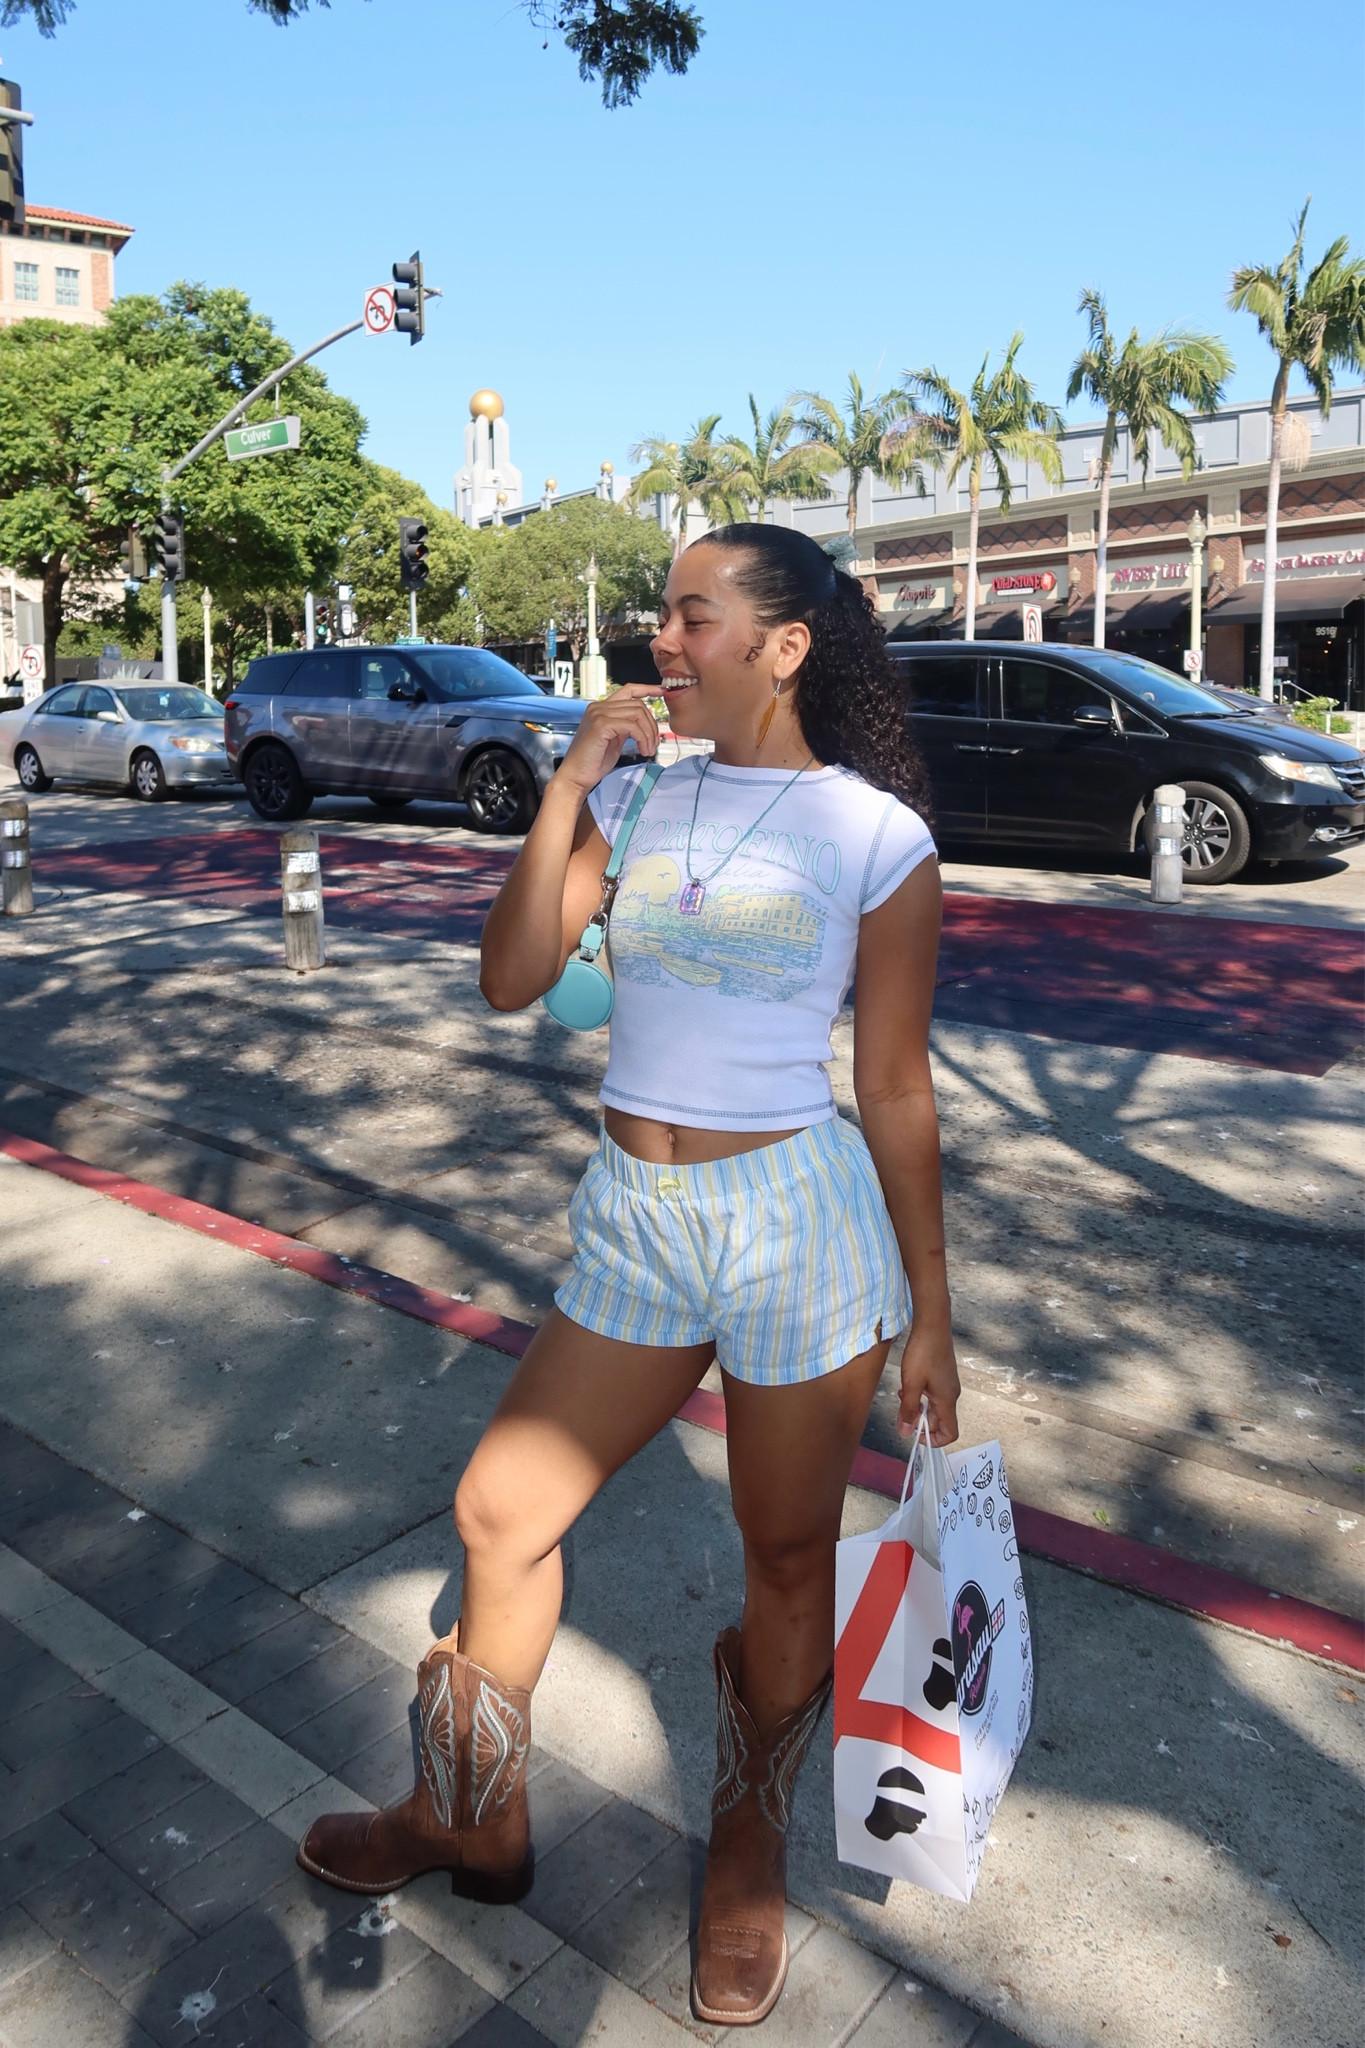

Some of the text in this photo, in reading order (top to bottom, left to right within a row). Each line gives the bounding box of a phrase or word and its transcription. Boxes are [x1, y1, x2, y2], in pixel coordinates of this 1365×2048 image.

[240, 429, 272, 446] Culver
[1013, 573, 1041, 590] STONE
[1115, 565, 1155, 583] SWEET
[958, 1623, 993, 1716] arasau
